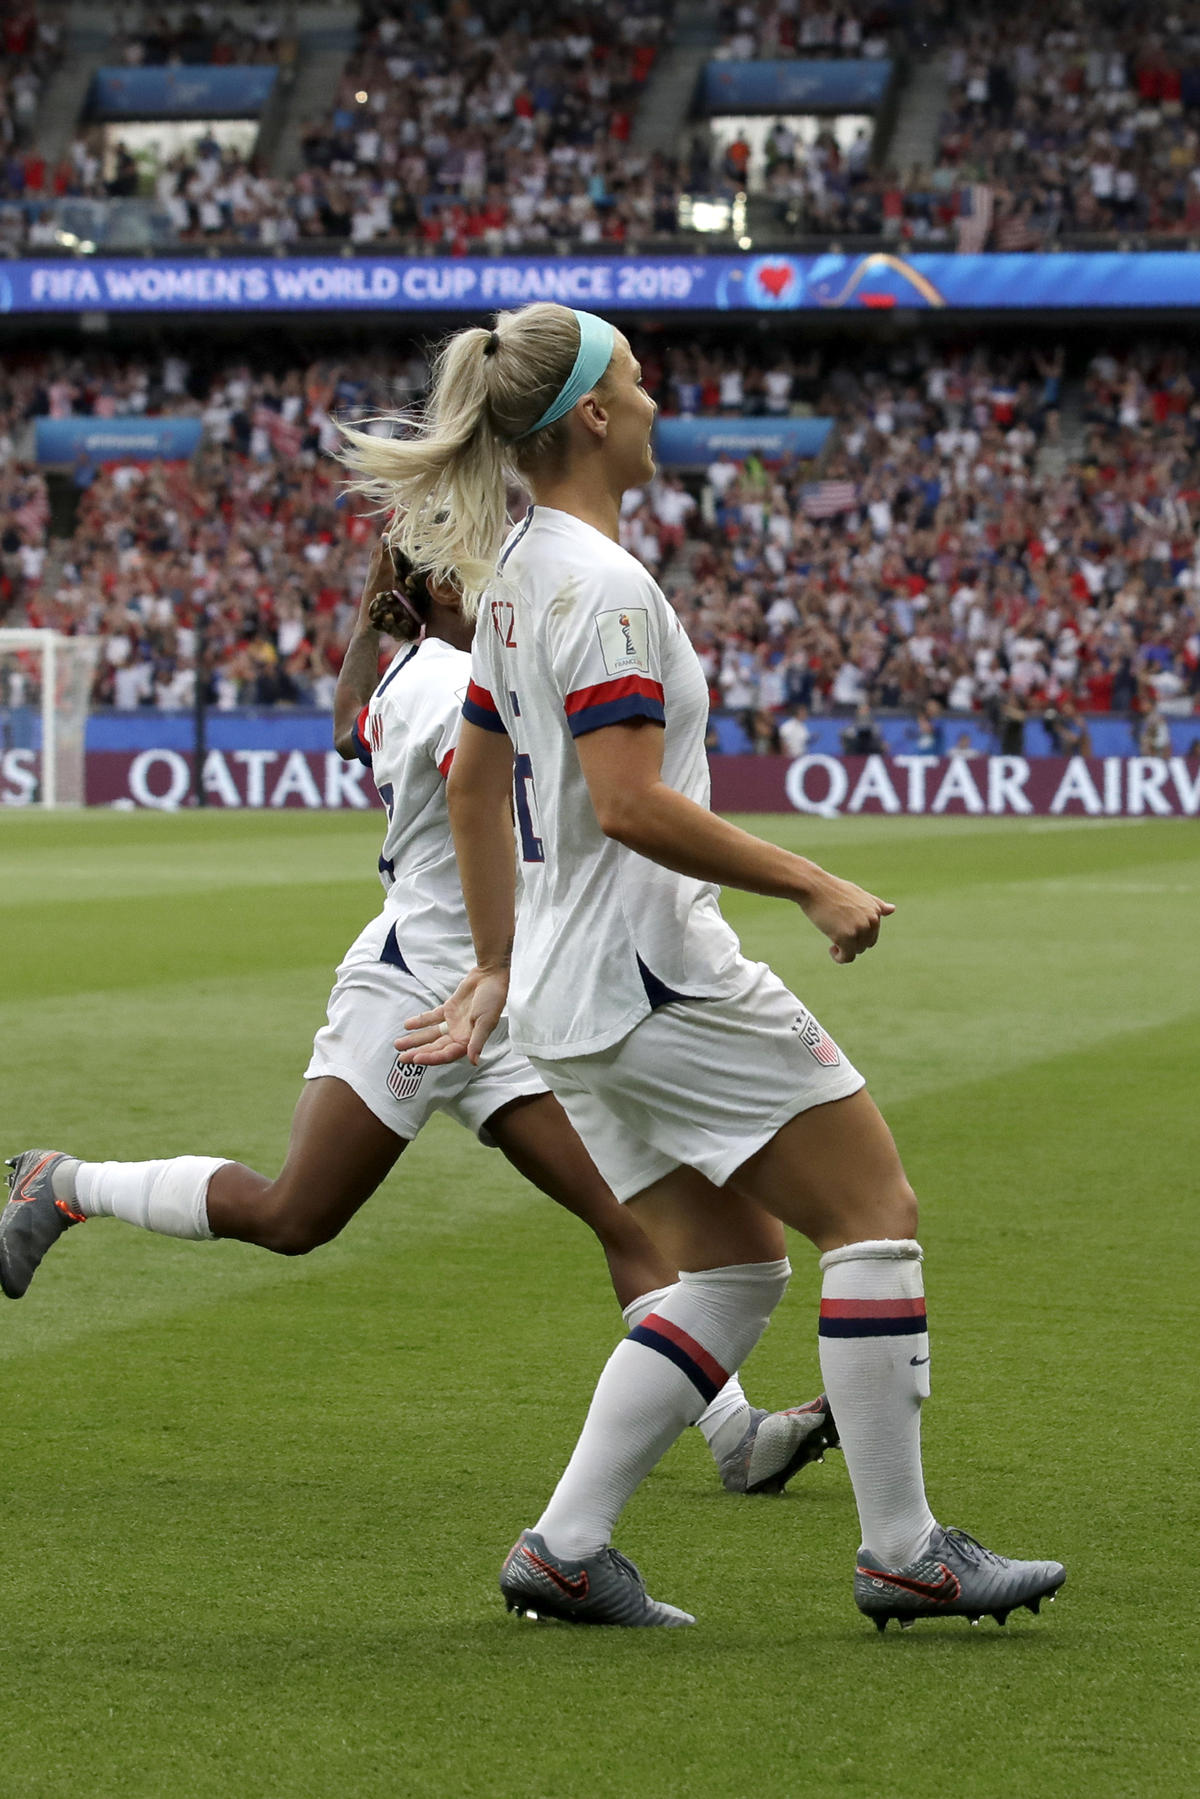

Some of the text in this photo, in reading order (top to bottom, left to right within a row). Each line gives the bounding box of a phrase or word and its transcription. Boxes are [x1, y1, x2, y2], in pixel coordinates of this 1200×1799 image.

[31, 267, 100, 301] FIFA
[103, 267, 268, 302] WOMEN'S
[272, 266, 400, 300] WORLD
[402, 266, 477, 300] CUP
[480, 266, 612, 300] FRANCE
[129, 748, 370, 812] QATAR
[785, 754, 1034, 818] QATAR
